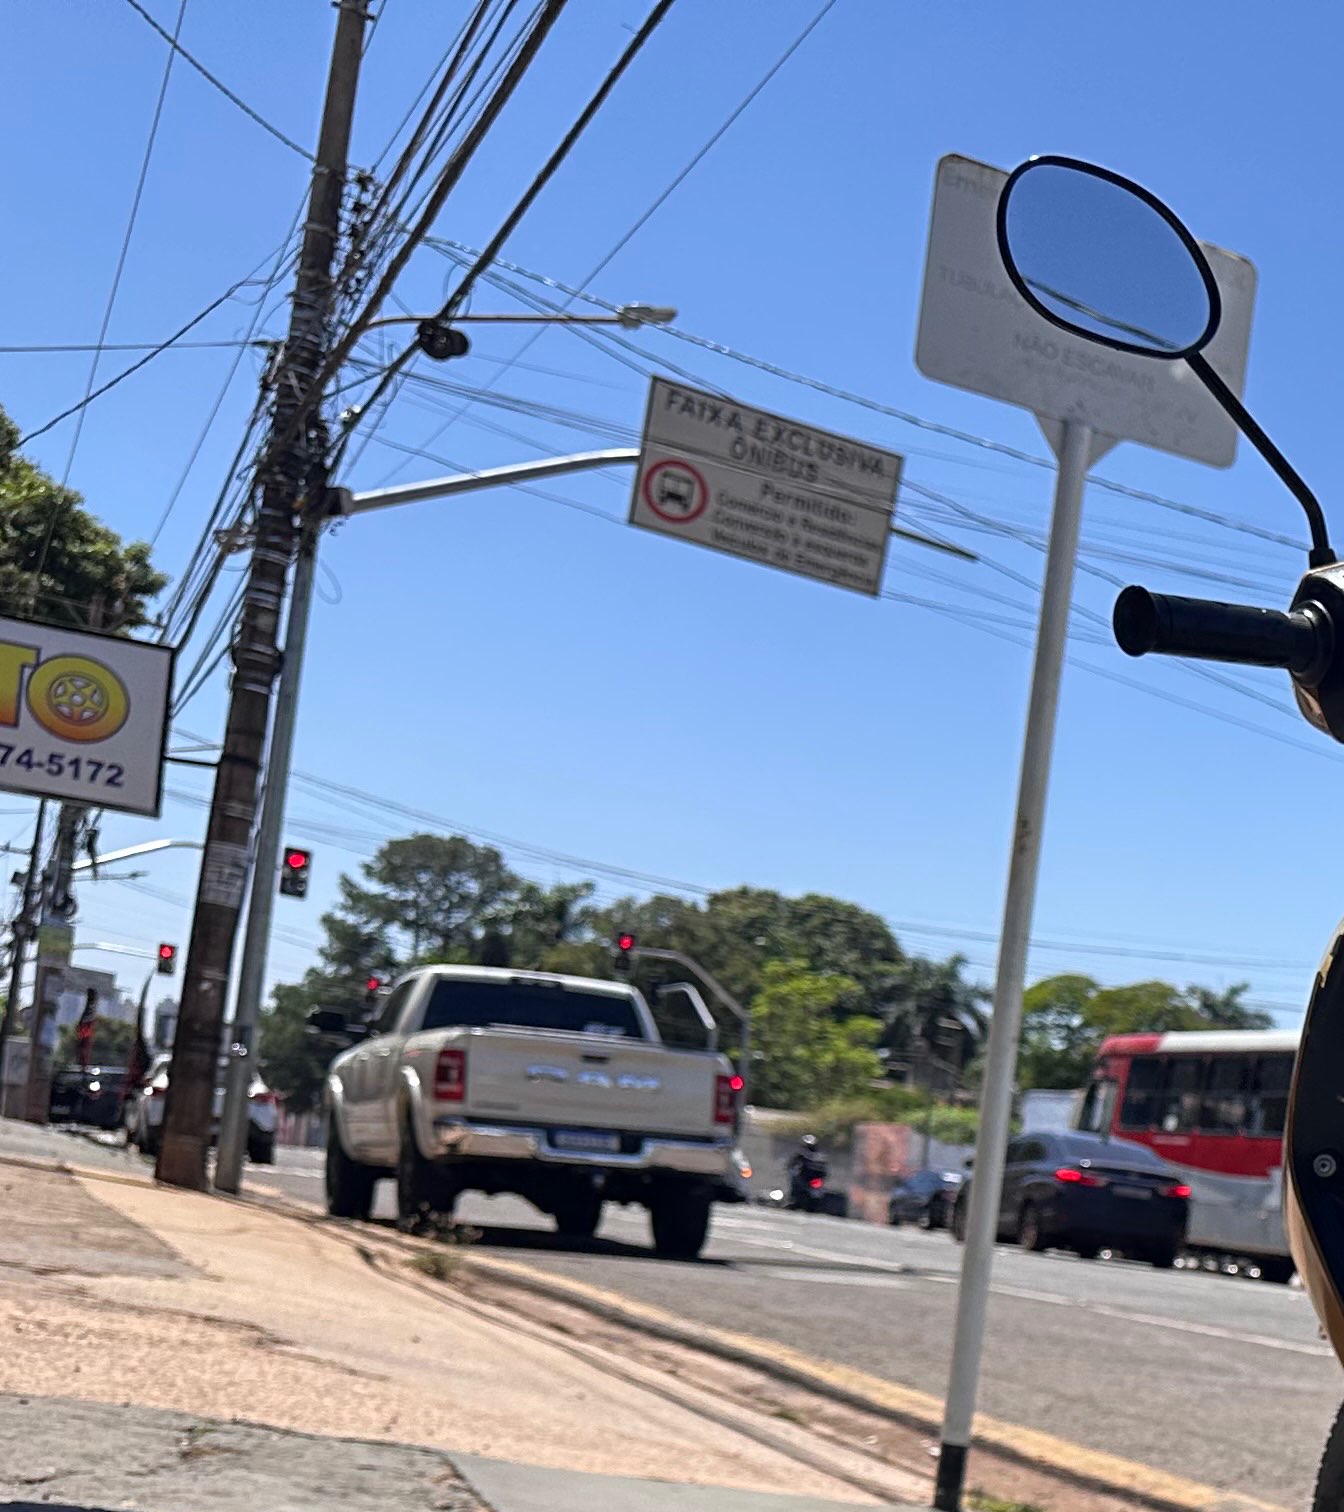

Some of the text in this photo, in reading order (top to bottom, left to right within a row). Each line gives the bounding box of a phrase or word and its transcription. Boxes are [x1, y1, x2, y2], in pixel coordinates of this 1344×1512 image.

[664, 389, 886, 476] FAIXA EXCLUSIVA
[729, 436, 820, 483] ÔNIBUS
[0, 743, 124, 787] 74-5172
